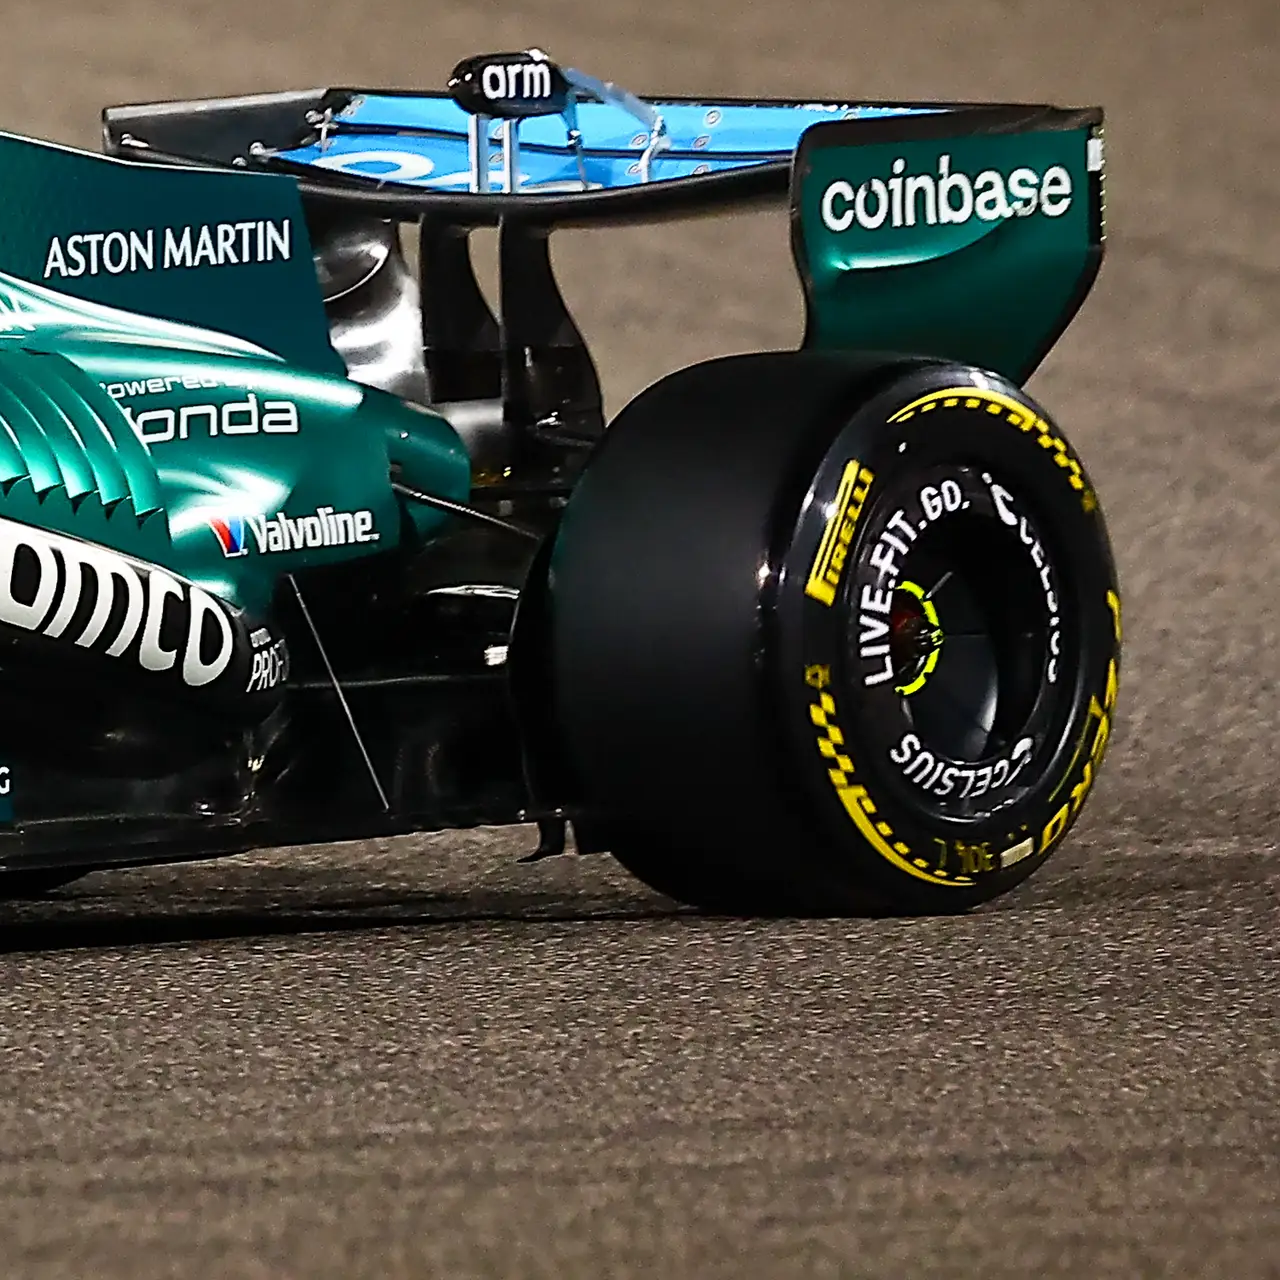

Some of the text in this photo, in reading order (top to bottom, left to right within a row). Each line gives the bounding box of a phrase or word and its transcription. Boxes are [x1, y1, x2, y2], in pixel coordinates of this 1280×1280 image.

[482, 60, 551, 100] arm
[821, 155, 1073, 232] coinbase
[44, 220, 293, 279] ASTON MARTIN
[98, 373, 218, 399] owered
[251, 507, 380, 556] Valvoline
[804, 458, 875, 608] PIRELLI
